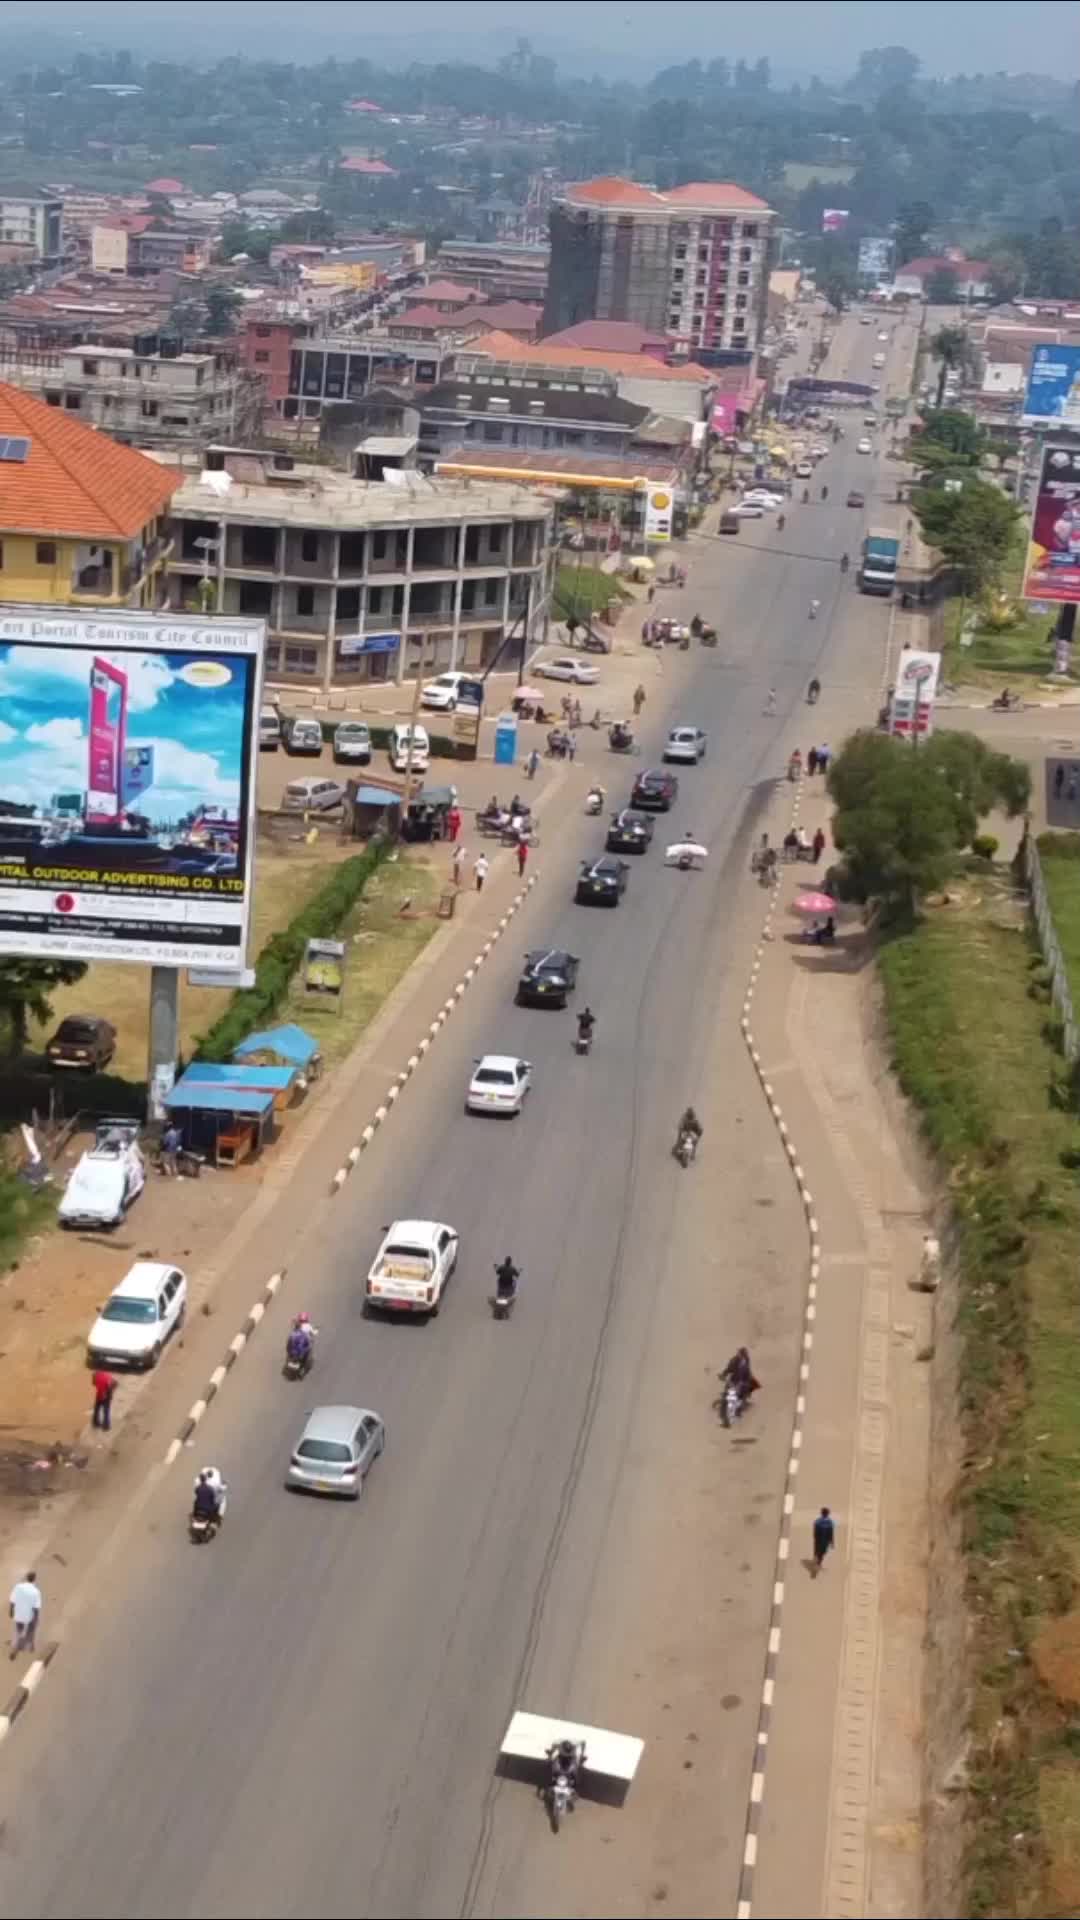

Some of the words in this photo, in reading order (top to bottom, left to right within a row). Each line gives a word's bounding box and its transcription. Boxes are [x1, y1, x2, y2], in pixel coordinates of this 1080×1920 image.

[32, 622, 79, 638] Portal
[84, 624, 150, 641] Tourism
[155, 629, 187, 645] City
[191, 630, 249, 647] Council
[33, 866, 98, 882] OUTDOOR
[102, 870, 190, 888] ADVERTISING
[192, 876, 214, 889] CO.
